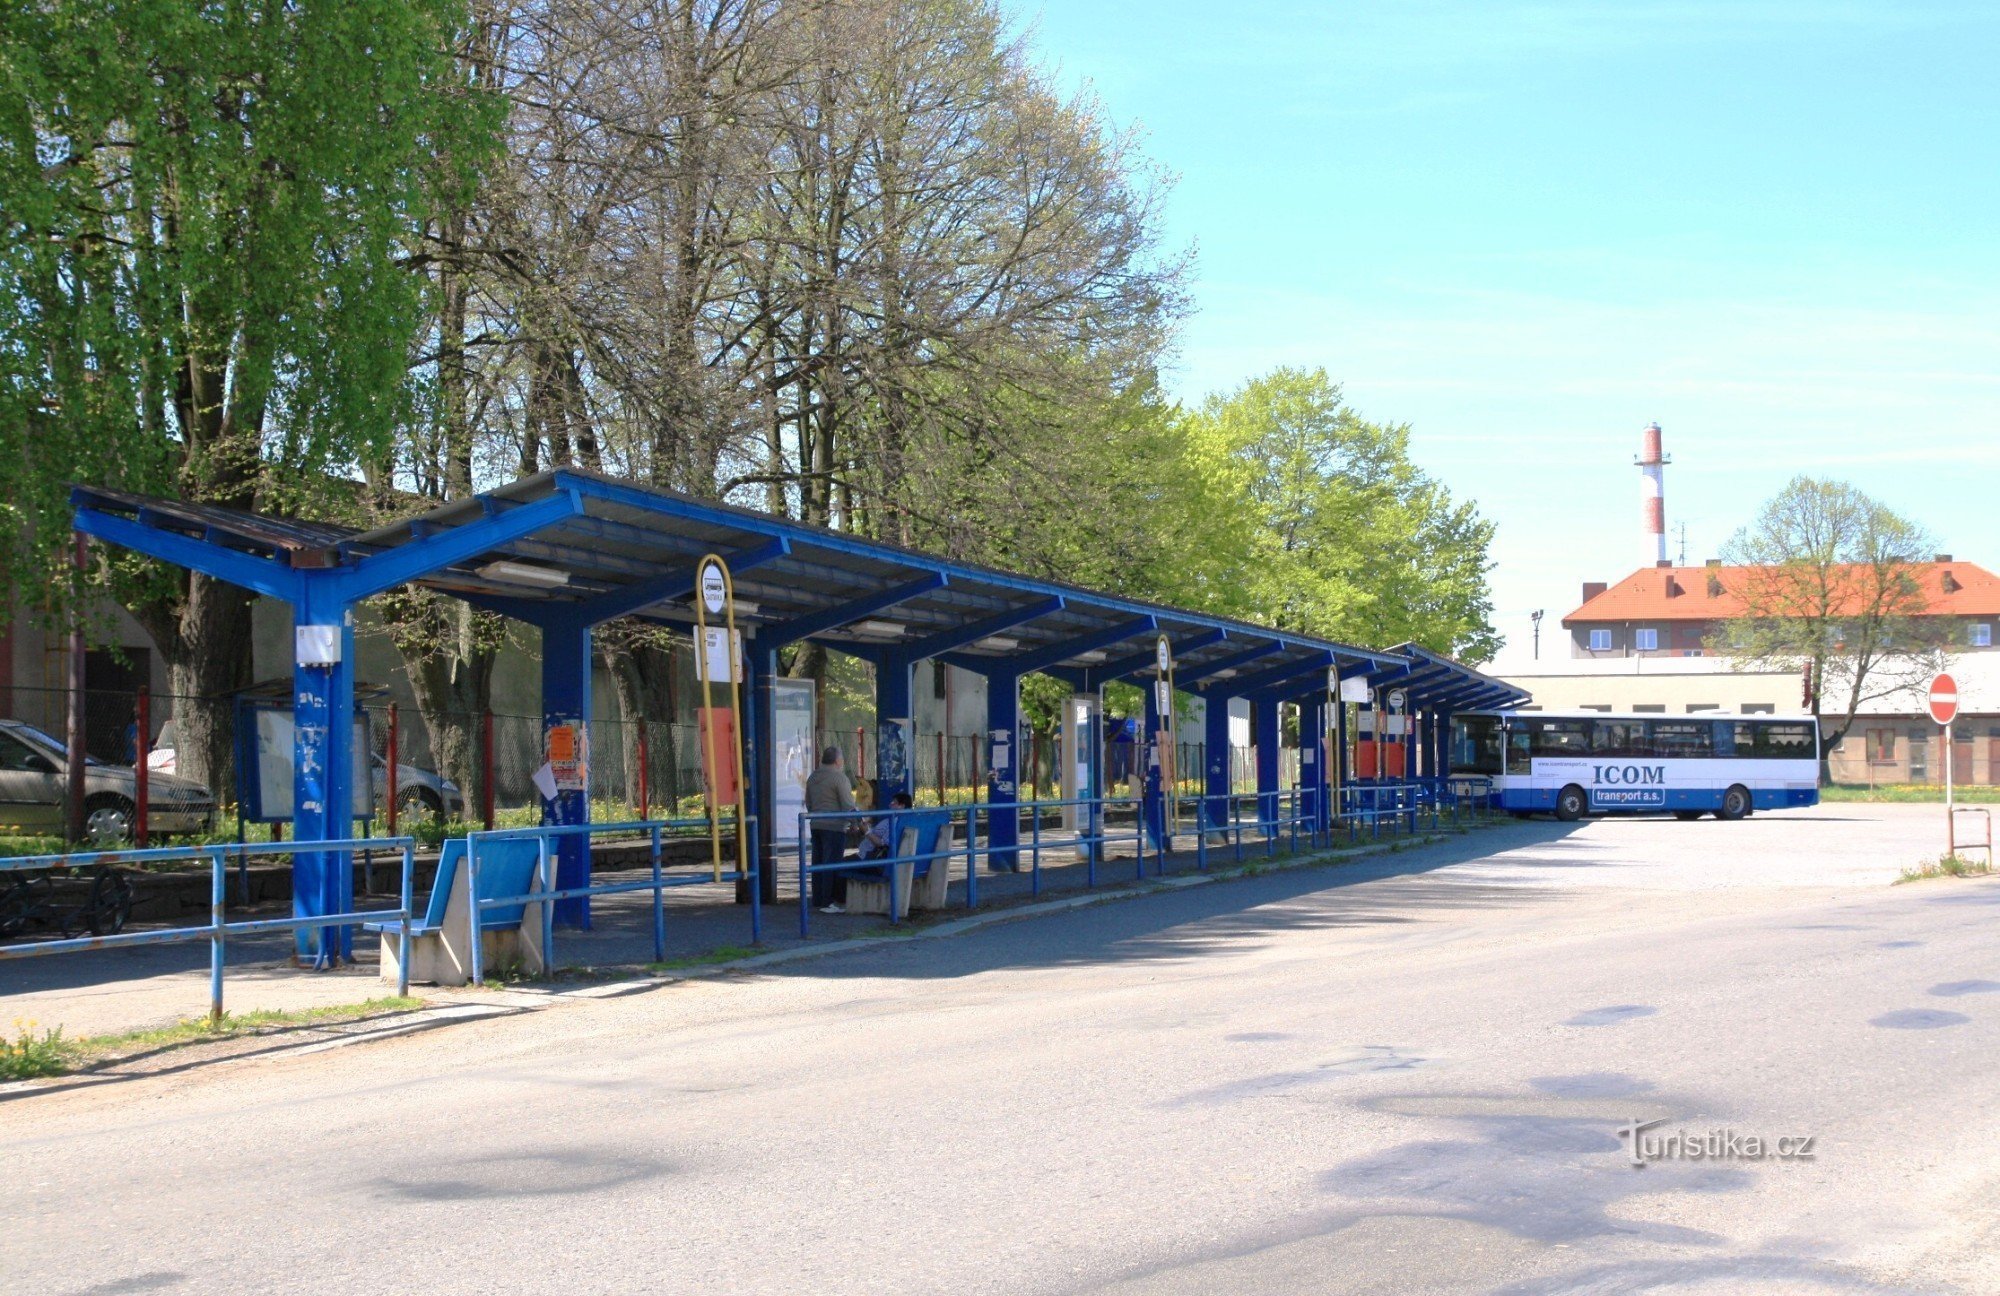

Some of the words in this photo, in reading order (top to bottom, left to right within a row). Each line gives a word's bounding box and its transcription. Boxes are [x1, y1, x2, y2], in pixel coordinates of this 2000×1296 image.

[1593, 765, 1665, 784] ICOM
[1596, 790, 1641, 803] transport
[1643, 791, 1660, 801] a.s.
